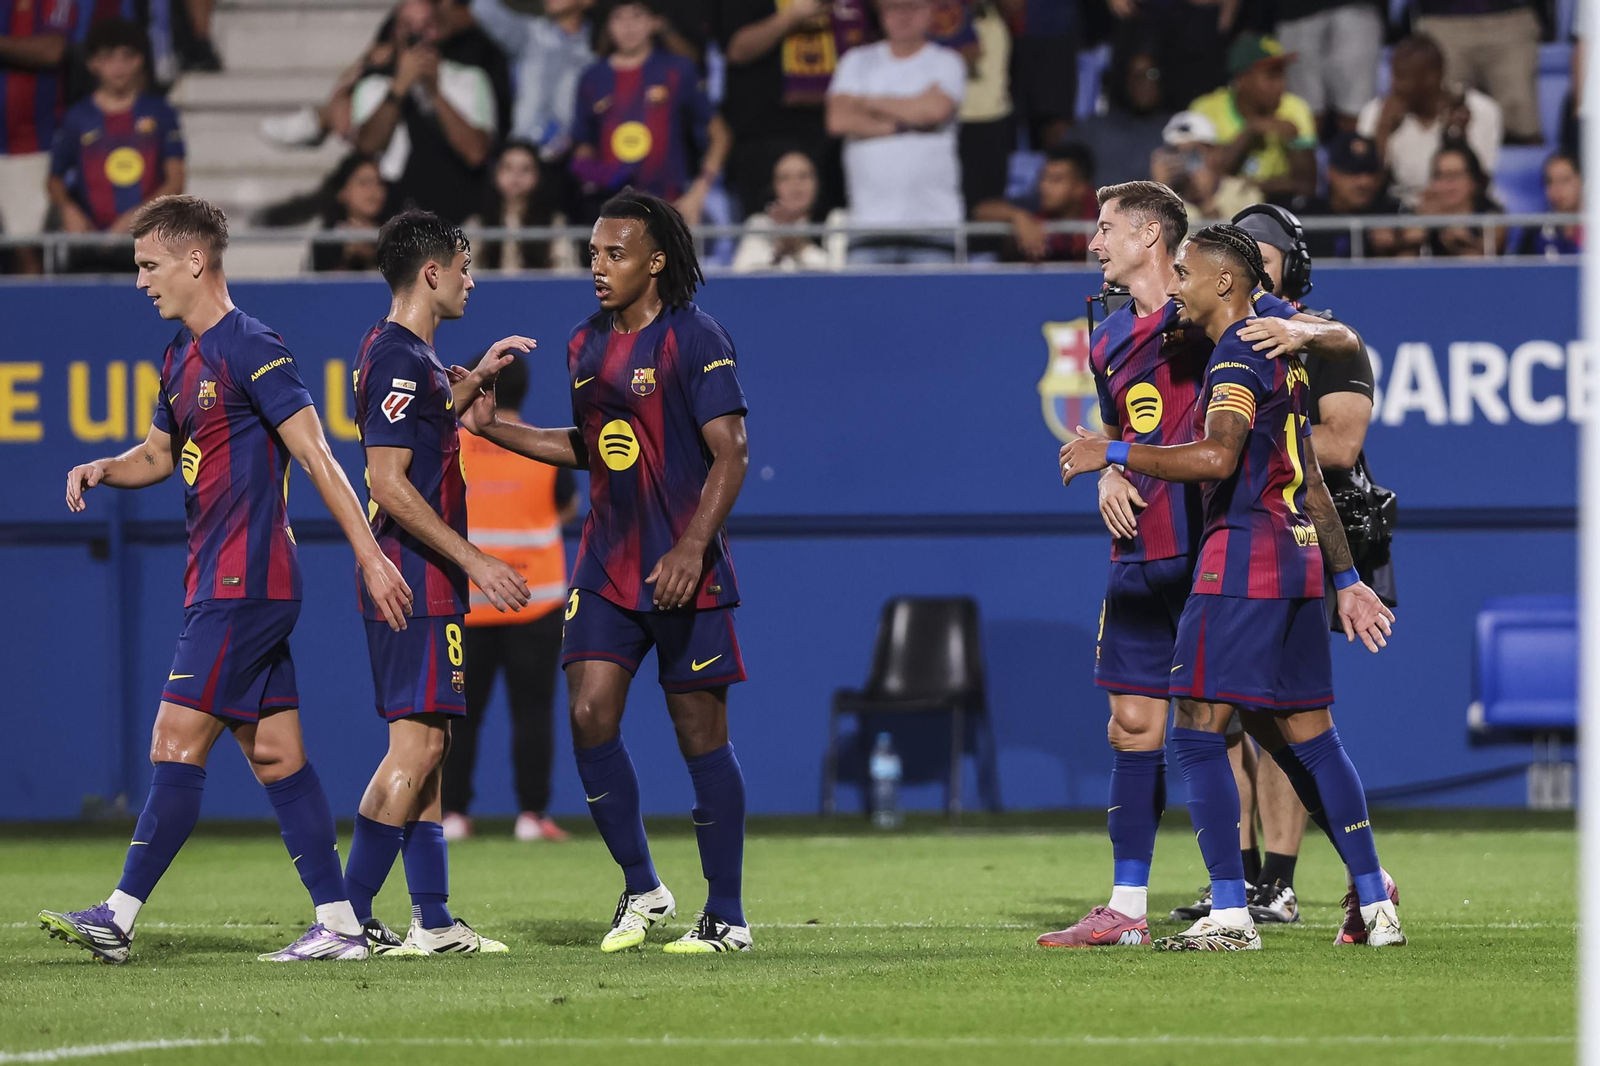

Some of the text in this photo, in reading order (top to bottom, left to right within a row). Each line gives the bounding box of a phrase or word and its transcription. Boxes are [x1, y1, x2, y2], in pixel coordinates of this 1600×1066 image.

[251, 357, 286, 382] AMBILIGHT
[1210, 361, 1250, 373] AMBILIGHT
[445, 623, 463, 666] 8
